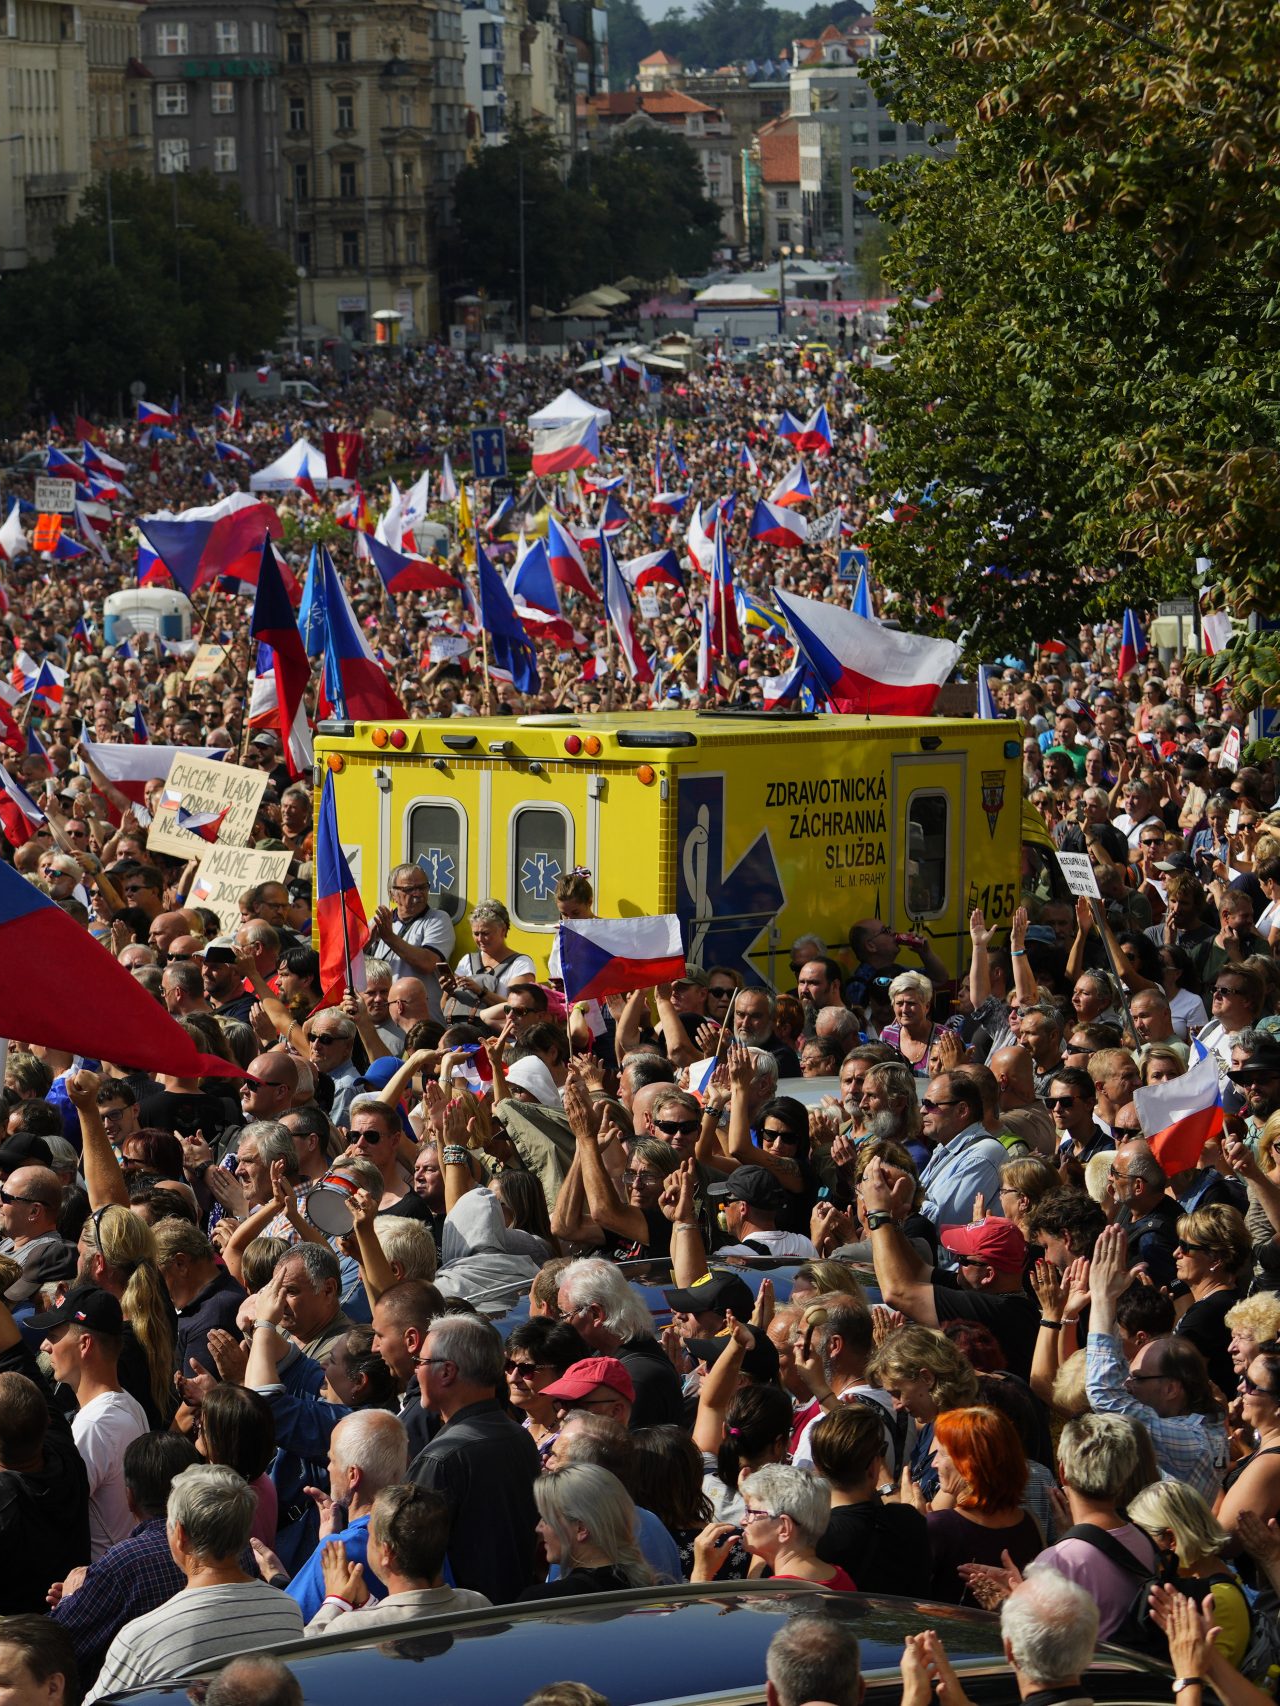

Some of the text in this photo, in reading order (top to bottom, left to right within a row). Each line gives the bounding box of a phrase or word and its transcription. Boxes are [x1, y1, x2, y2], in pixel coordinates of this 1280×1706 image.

[170, 765, 259, 804] CHCEME VLÁDU
[765, 769, 887, 807] ZDRAVOTNICKÁ
[789, 802, 887, 839] ZÁCHRANNÁ
[206, 850, 286, 880] MÁME TOHO
[825, 836, 886, 869] SLUŽBA
[212, 881, 246, 905] DOST
[834, 872, 886, 888] HL. M. PRAHY
[980, 883, 1016, 920] 155
